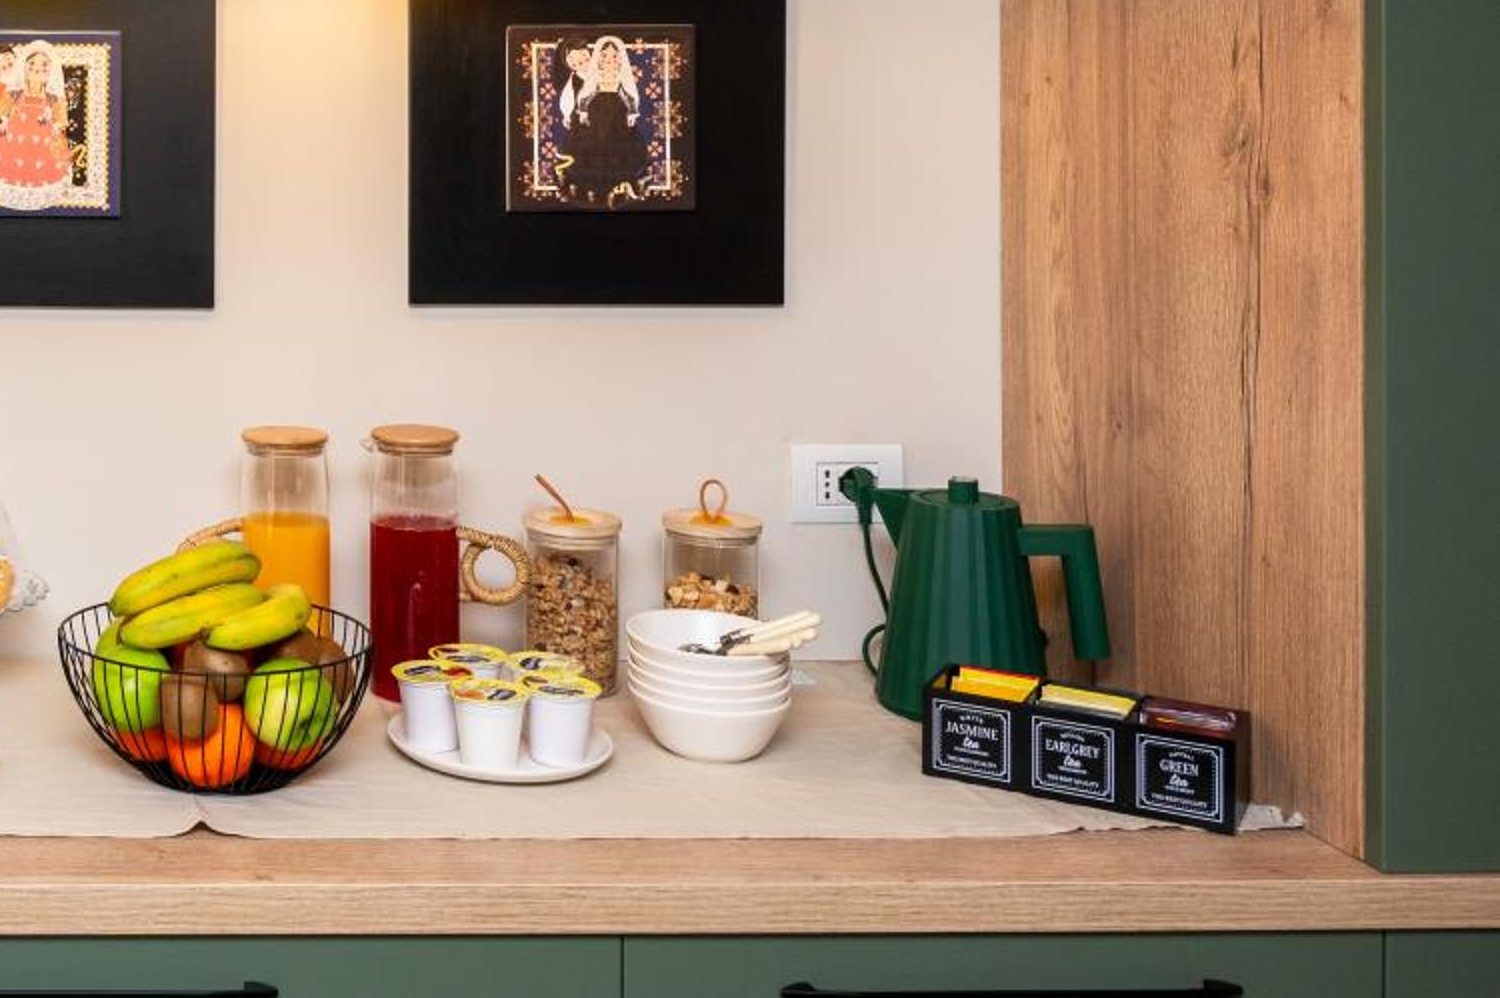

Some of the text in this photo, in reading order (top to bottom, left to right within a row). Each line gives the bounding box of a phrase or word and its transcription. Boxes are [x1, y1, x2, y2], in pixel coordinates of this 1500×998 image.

[946, 721, 999, 741] JASMINE
[963, 736, 980, 749] tea
[1159, 759, 1199, 777] GREEN
